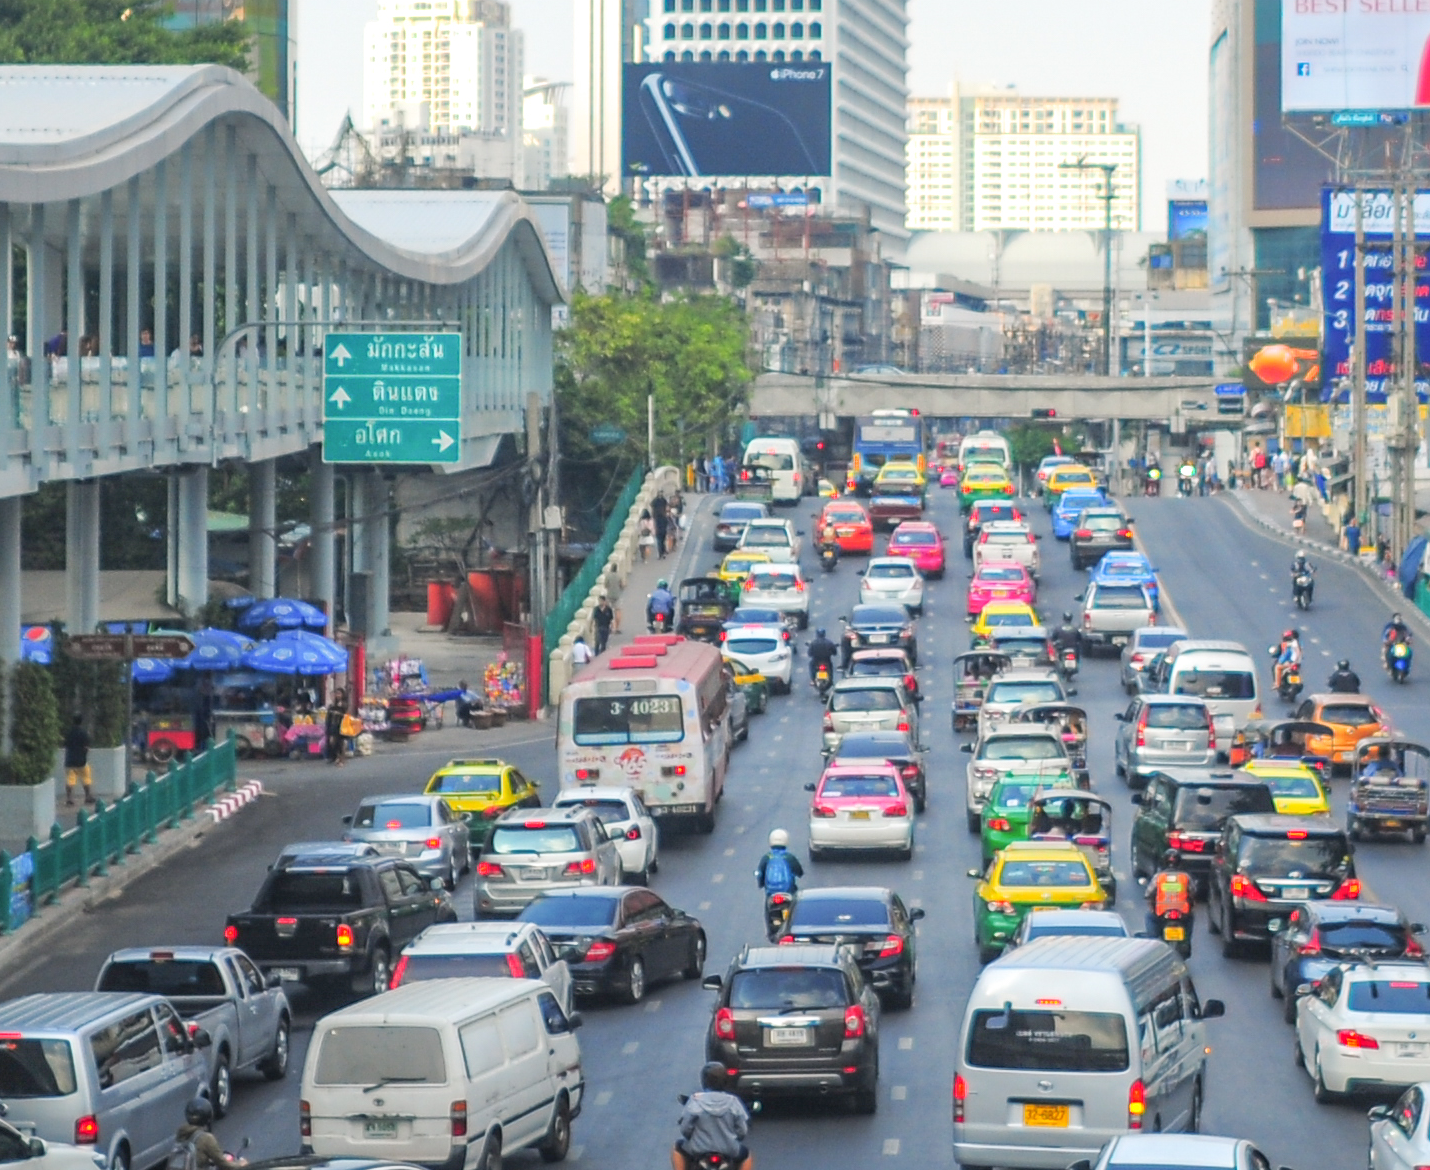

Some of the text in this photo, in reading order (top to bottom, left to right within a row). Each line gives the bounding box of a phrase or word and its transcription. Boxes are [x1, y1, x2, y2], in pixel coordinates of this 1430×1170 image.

[779, 69, 825, 80] iPhone 7
[1334, 280, 1349, 300] 2
[1333, 310, 1348, 329] 3
[366, 335, 444, 359] มักกะสัน
[381, 364, 431, 372] Makkasan
[372, 380, 439, 401] ดินแดง
[378, 406, 431, 417] Din Daeng
[355, 420, 402, 444] อโศก
[365, 450, 391, 458] Asok
[623, 681, 632, 692] 2
[630, 700, 680, 715] 40231
